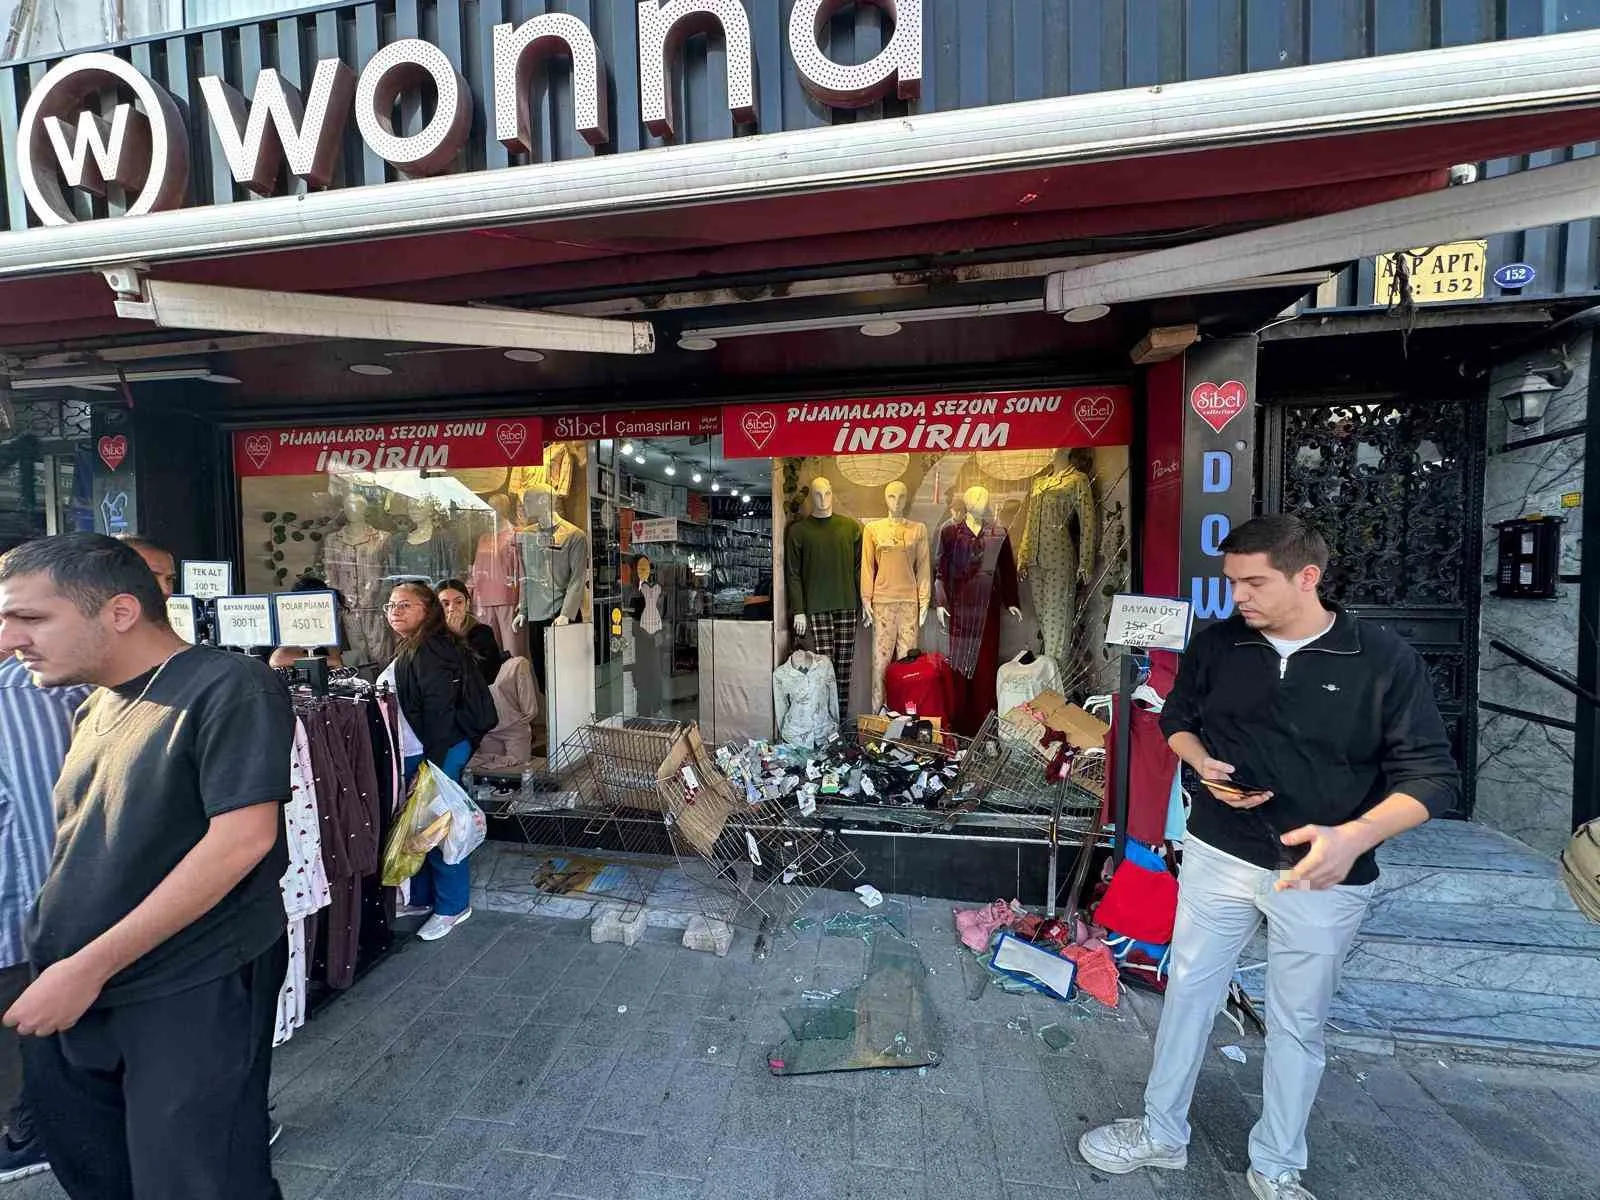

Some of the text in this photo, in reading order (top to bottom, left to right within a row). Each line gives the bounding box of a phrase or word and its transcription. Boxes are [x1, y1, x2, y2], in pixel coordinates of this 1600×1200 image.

[1432, 253, 1479, 275] APT.
[1505, 268, 1526, 281] 152
[1433, 278, 1473, 294] 152
[1196, 390, 1241, 409] Sibel
[786, 395, 1062, 423] PİJAMALARDA SEZON SONU
[1078, 403, 1110, 417] Sibel
[554, 414, 607, 437] Sibel
[615, 418, 690, 437] Çamaşırları
[745, 417, 772, 430] Sibel
[279, 422, 487, 446] PİJAMALARDA SEZON SONU
[832, 417, 1010, 452] İNDİRİM
[315, 440, 449, 472] İNDİRİM
[208, 568, 222, 577] ALT
[209, 583, 219, 591] TL
[1121, 604, 1157, 614] BAYAN
[174, 617, 184, 627] TL
[232, 618, 258, 628] 300 TL
[292, 617, 325, 629] 450 TL
